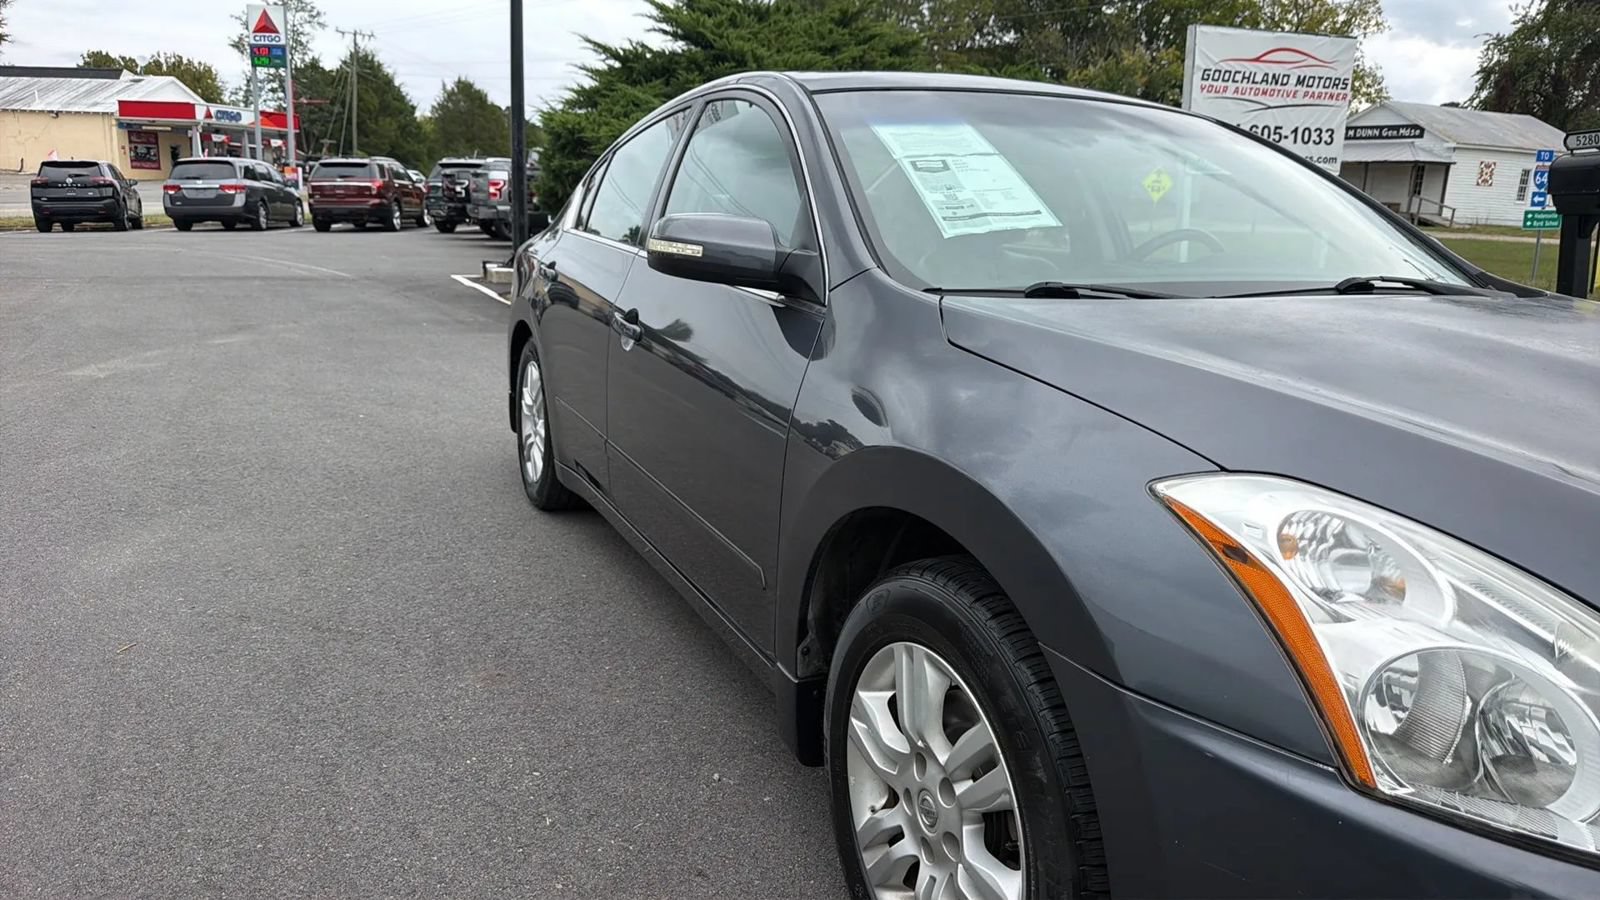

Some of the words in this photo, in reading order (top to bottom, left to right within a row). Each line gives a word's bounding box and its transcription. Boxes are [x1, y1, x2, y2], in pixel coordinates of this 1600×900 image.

[1201, 68, 1291, 87] GOOCHLAND
[1295, 75, 1349, 90] MOTORS
[1200, 84, 1228, 94] YOUR
[1232, 86, 1299, 98] AUTOMOTIVE
[1302, 91, 1348, 101] PARTNER
[215, 110, 242, 122] CITGO
[1356, 128, 1380, 137] DUNN
[1576, 135, 1600, 146] 5280
[1540, 152, 1550, 160] TO
[1535, 173, 1548, 184] 64
